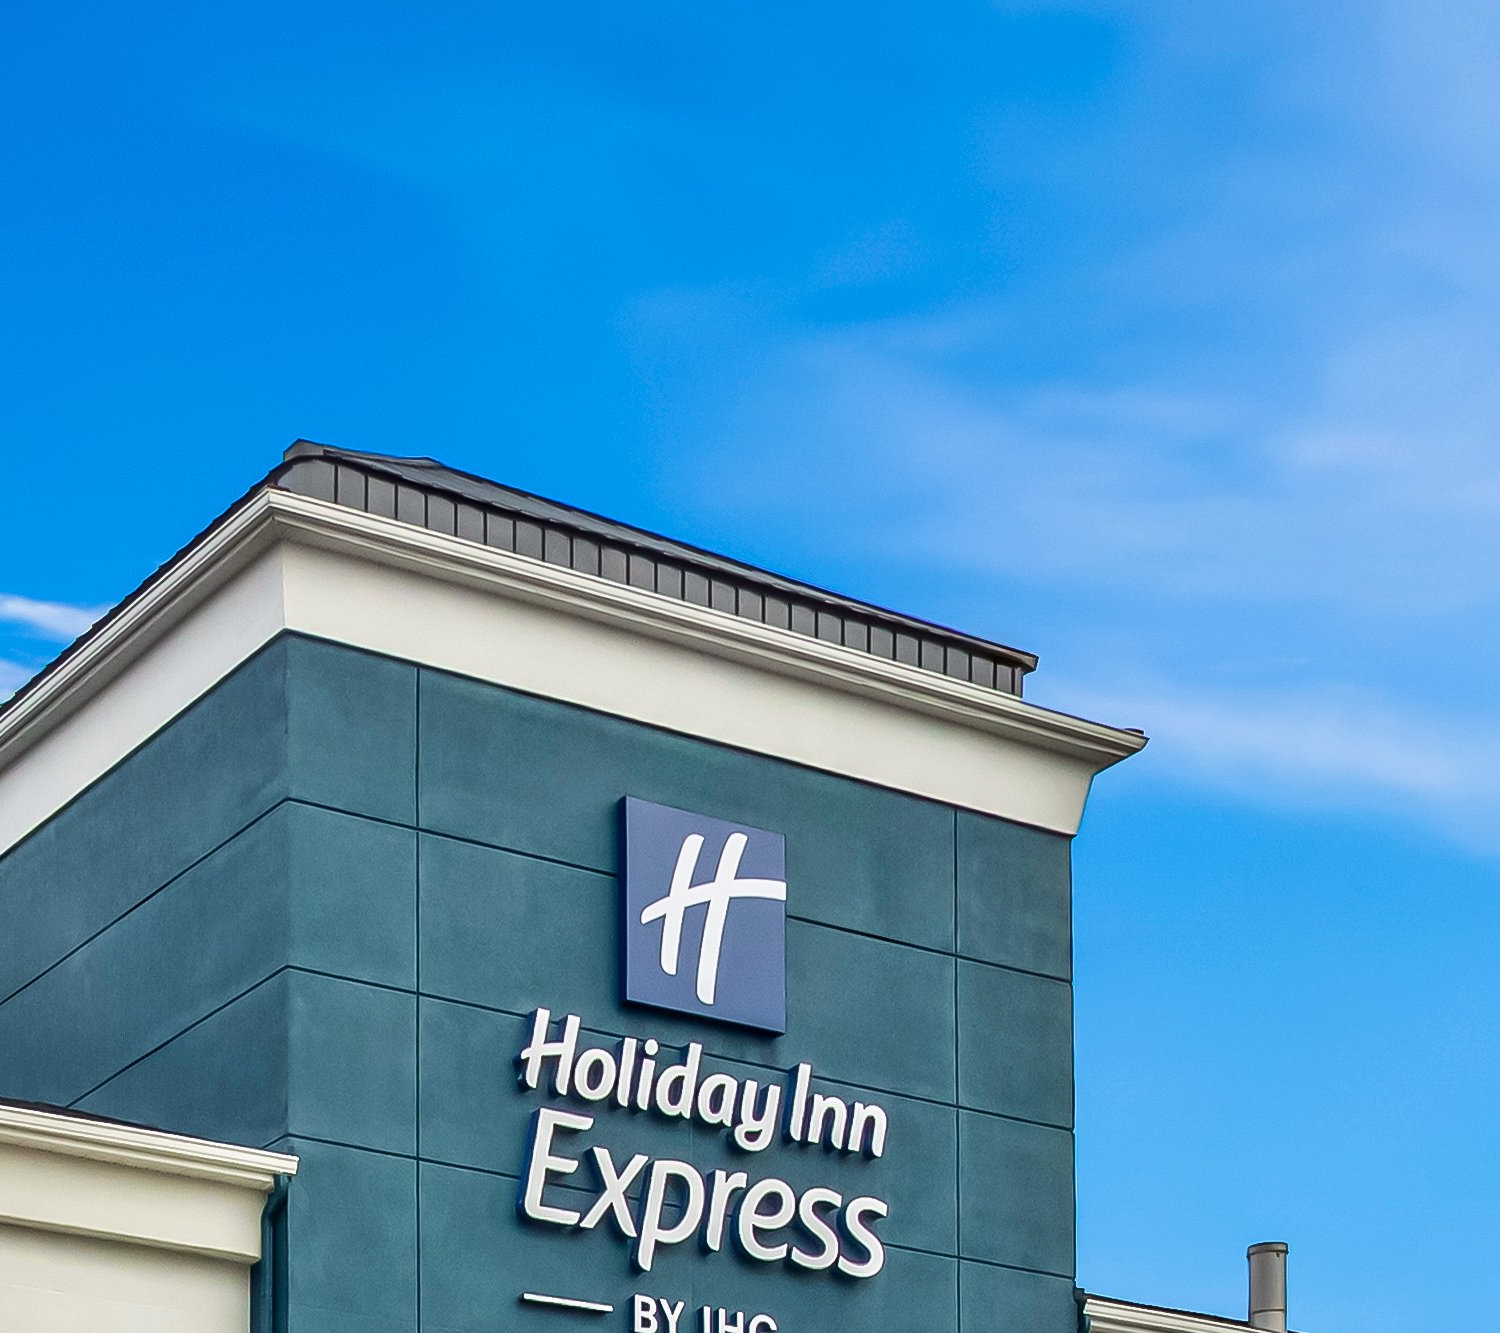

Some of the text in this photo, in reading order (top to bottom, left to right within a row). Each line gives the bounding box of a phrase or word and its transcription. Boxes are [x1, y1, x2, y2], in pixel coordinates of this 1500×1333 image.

[520, 1007, 888, 1158] Holiday Inn
[522, 1107, 888, 1279] Express
